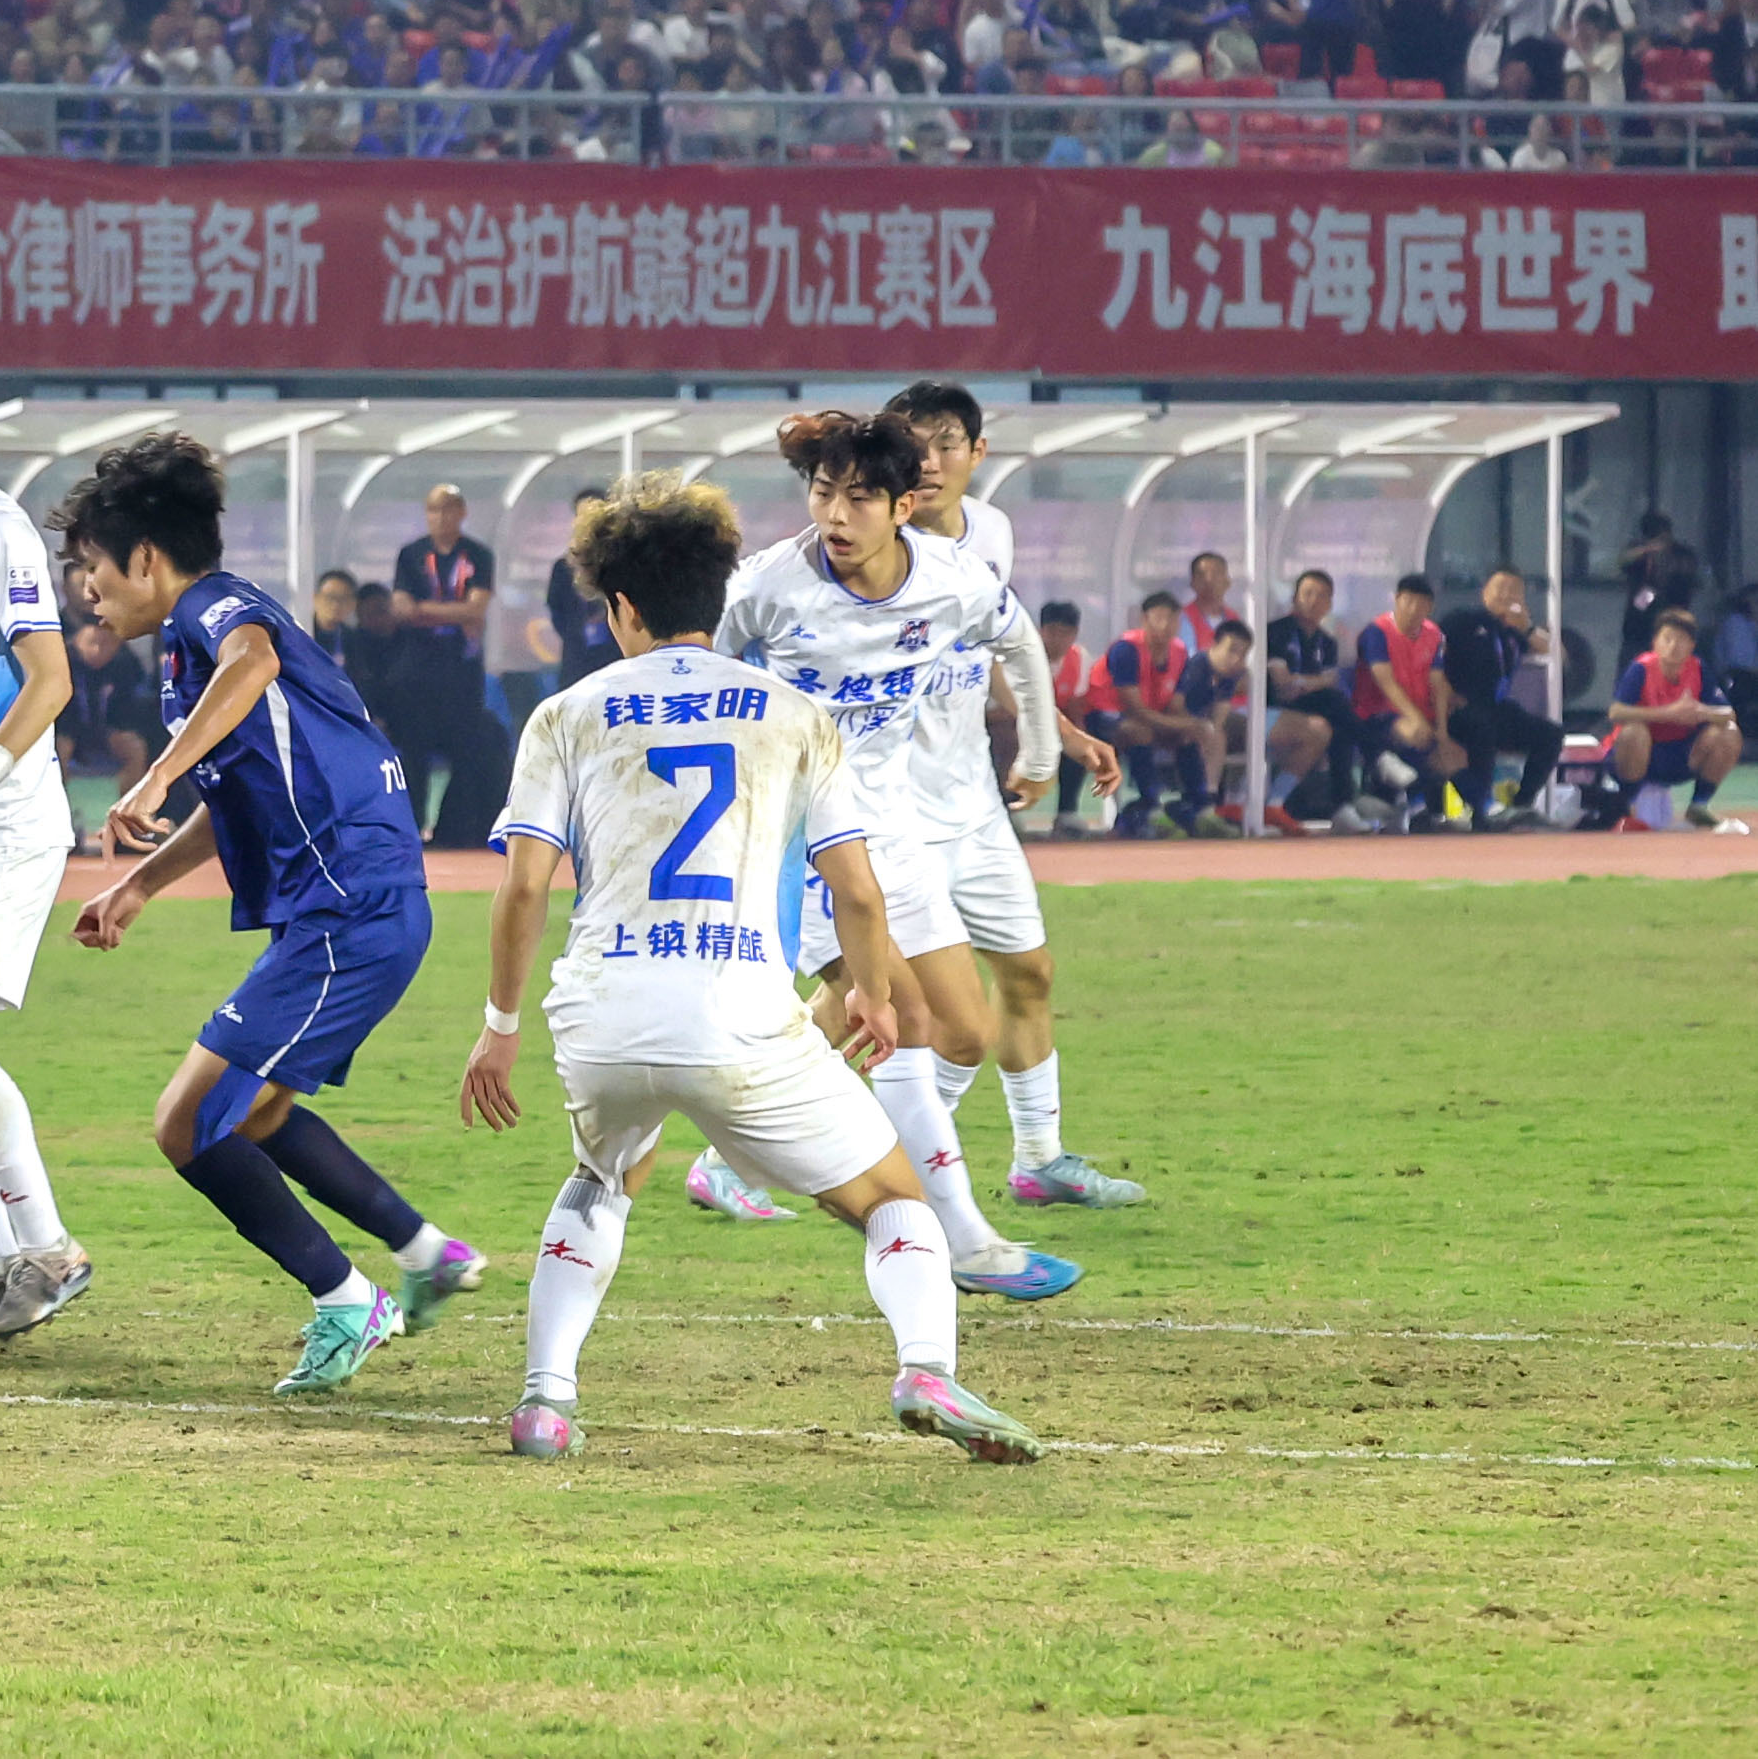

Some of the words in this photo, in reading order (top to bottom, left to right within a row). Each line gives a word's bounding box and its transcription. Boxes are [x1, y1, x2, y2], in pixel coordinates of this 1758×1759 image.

[382, 202, 997, 330] 法治护航赣超九江赛区
[1101, 205, 1655, 335] 九江海底世界
[604, 688, 770, 730] 钱家明
[646, 743, 737, 903] 2
[602, 919, 768, 964] 上镇精酿
